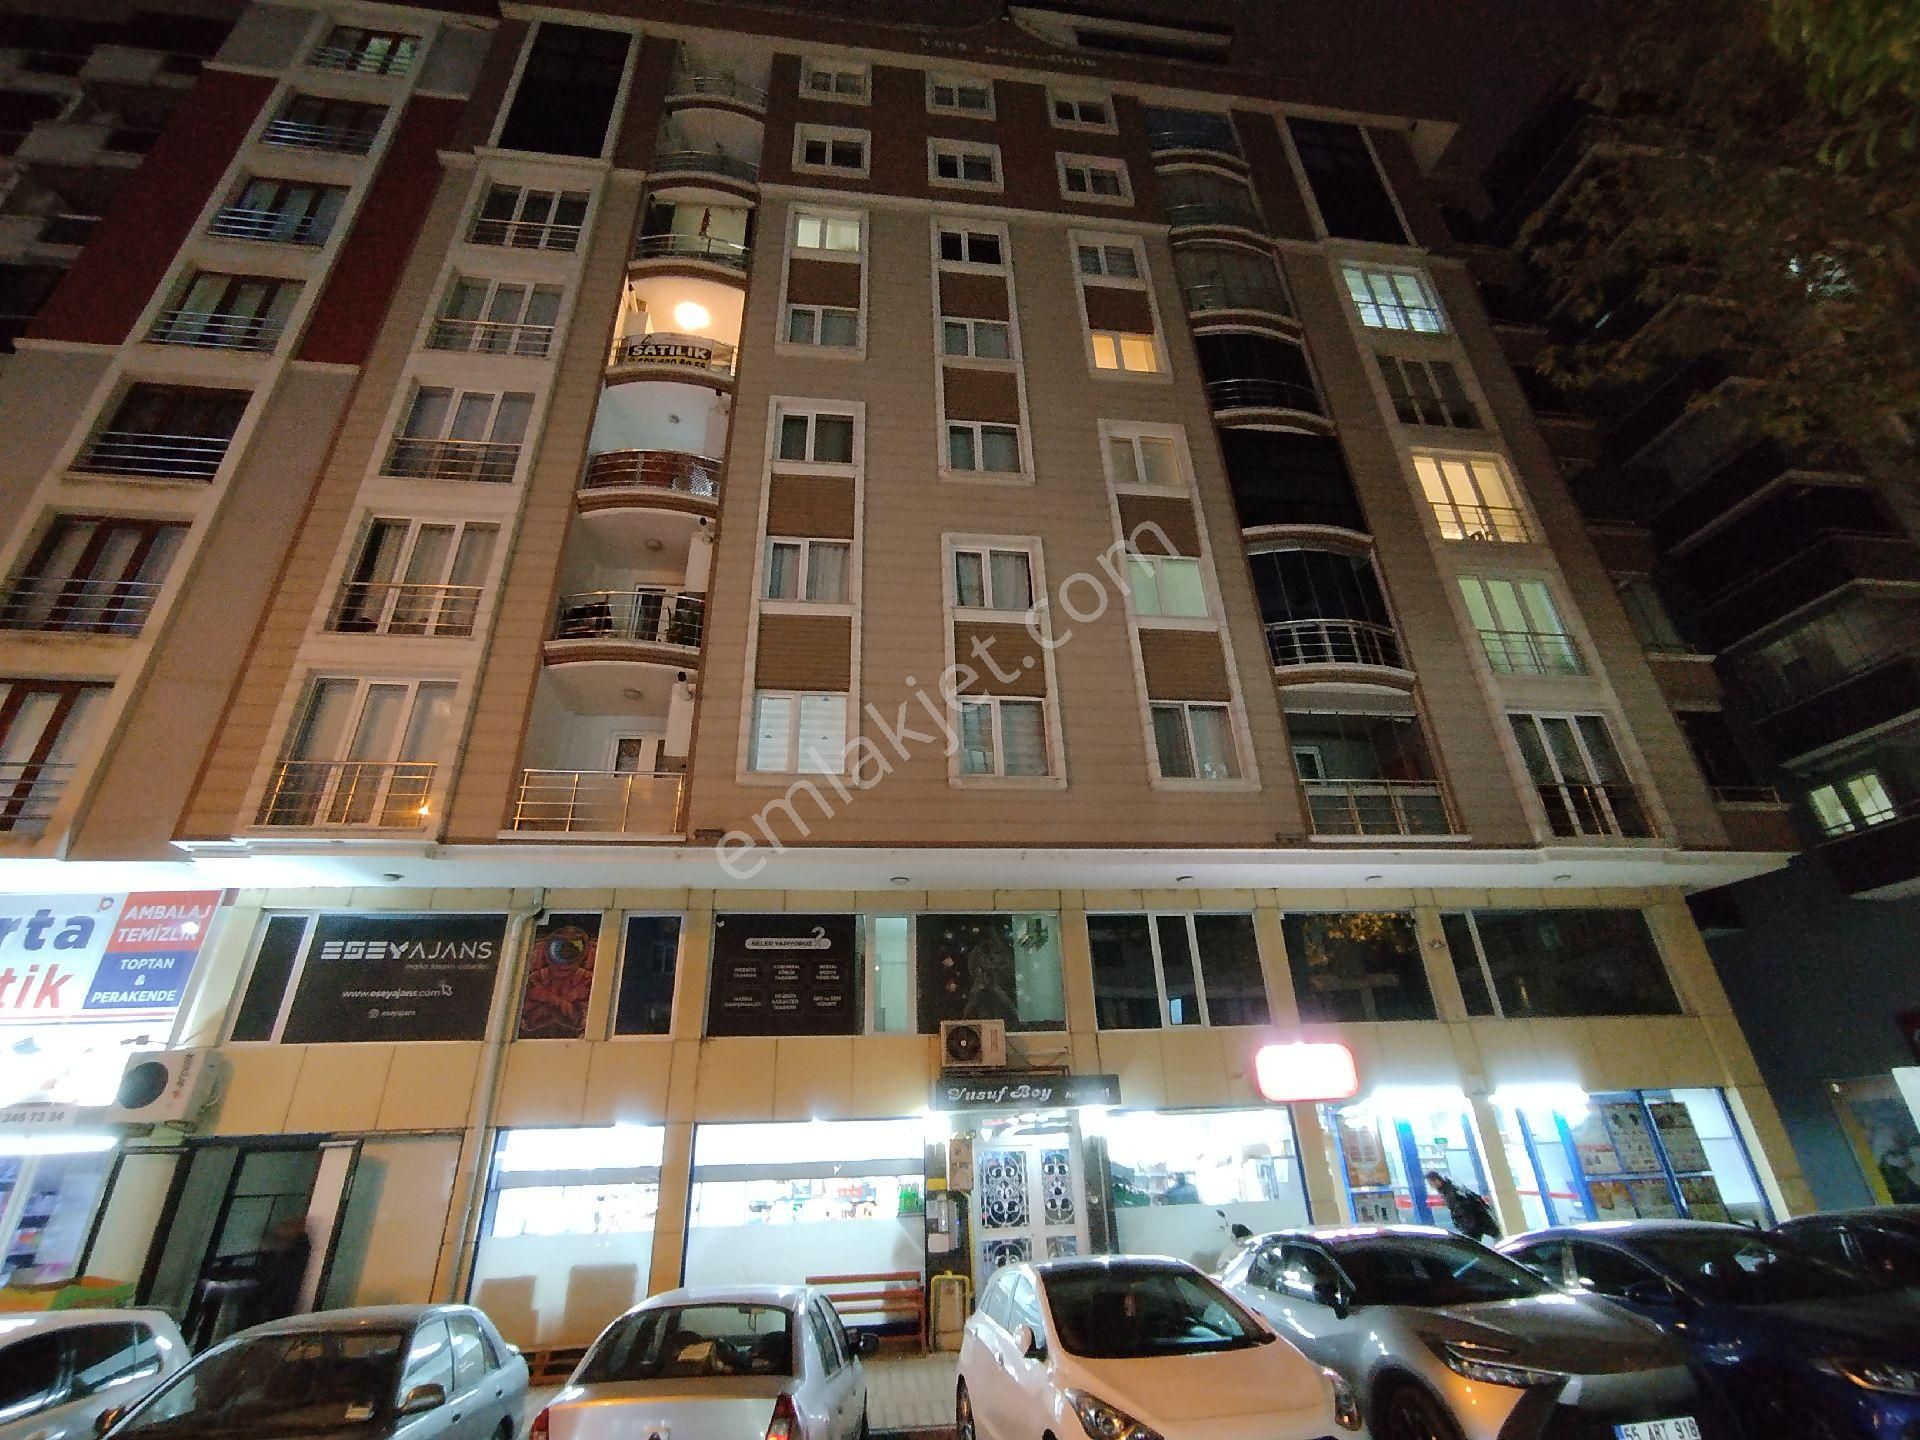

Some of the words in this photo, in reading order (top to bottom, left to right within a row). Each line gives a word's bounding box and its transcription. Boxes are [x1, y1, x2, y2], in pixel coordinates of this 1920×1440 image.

[631, 345, 707, 359] SATILIK
[125, 904, 212, 920] AMBALAJ
[120, 958, 175, 970] TOPTAN
[134, 974, 146, 986] &
[91, 989, 178, 1003] PERAKENDE
[947, 1085, 1008, 1103] Yusuf
